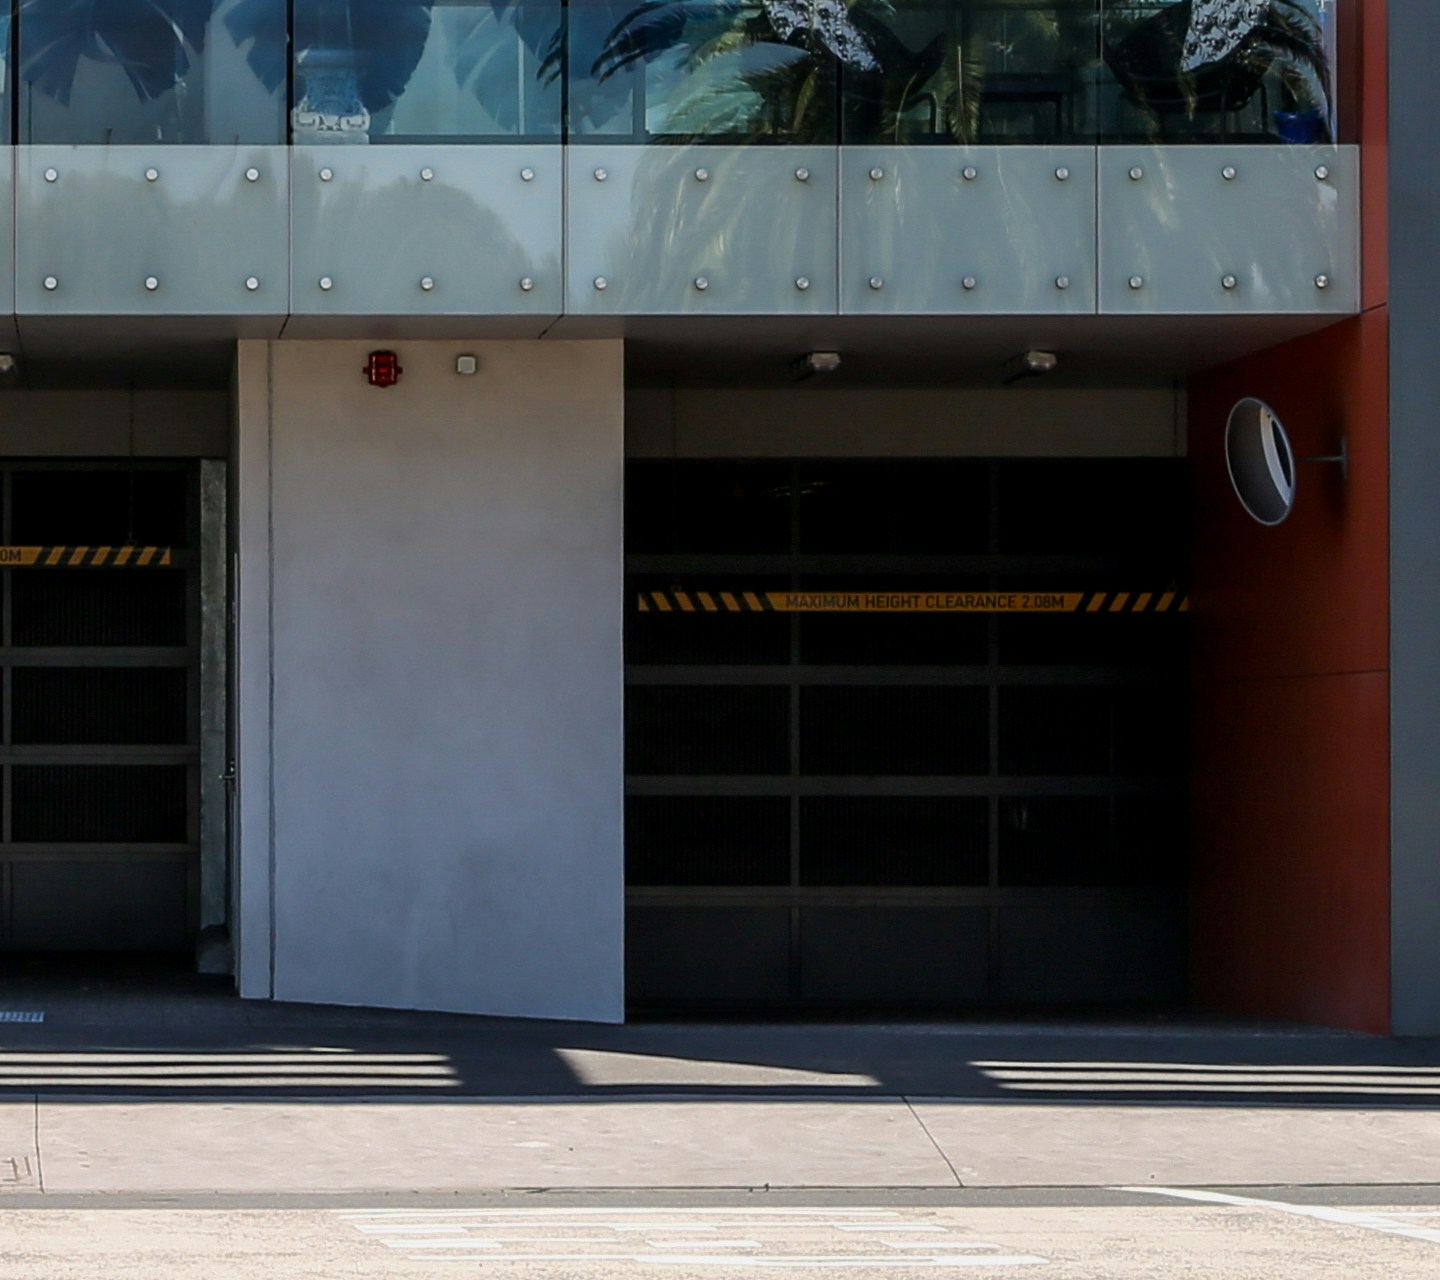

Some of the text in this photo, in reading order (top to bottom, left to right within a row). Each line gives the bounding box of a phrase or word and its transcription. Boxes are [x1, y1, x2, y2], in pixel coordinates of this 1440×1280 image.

[785, 594, 1065, 609] MAXIMUM HEIGHT CLEARANCE 2.08M
